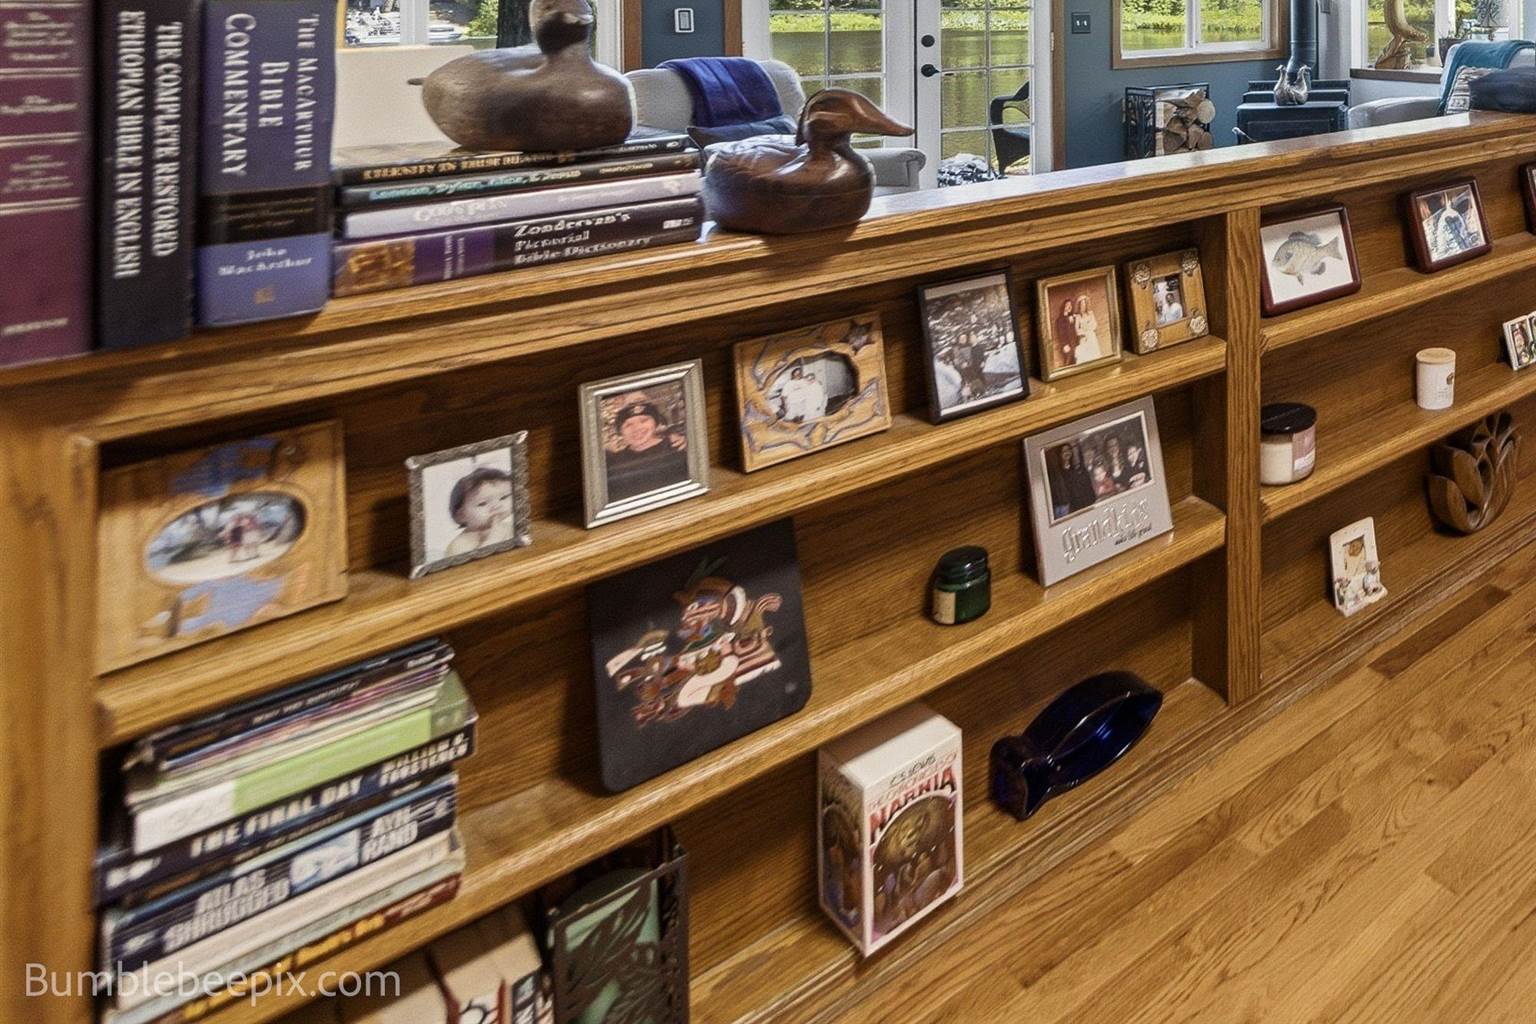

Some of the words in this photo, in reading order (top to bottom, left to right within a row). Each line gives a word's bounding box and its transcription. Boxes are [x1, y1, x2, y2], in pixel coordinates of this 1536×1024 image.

[117, 10, 145, 110] ETHIOPIAN
[156, 21, 182, 60] THE
[297, 13, 320, 48] THE
[153, 62, 182, 158] COMPLETE
[221, 13, 257, 176] COMMENTARY
[258, 61, 290, 128] BIBLE
[116, 114, 143, 168] BIBLE
[115, 172, 142, 193] IN
[151, 161, 180, 257] RESTORED
[114, 196, 142, 279] ENGLISH
[513, 211, 631, 238] Zondervan's
[190, 821, 242, 858] THE
[243, 794, 317, 838] FINAL
[320, 775, 363, 808] DAY
[361, 820, 418, 865] RAND
[869, 765, 958, 846] NARNIA
